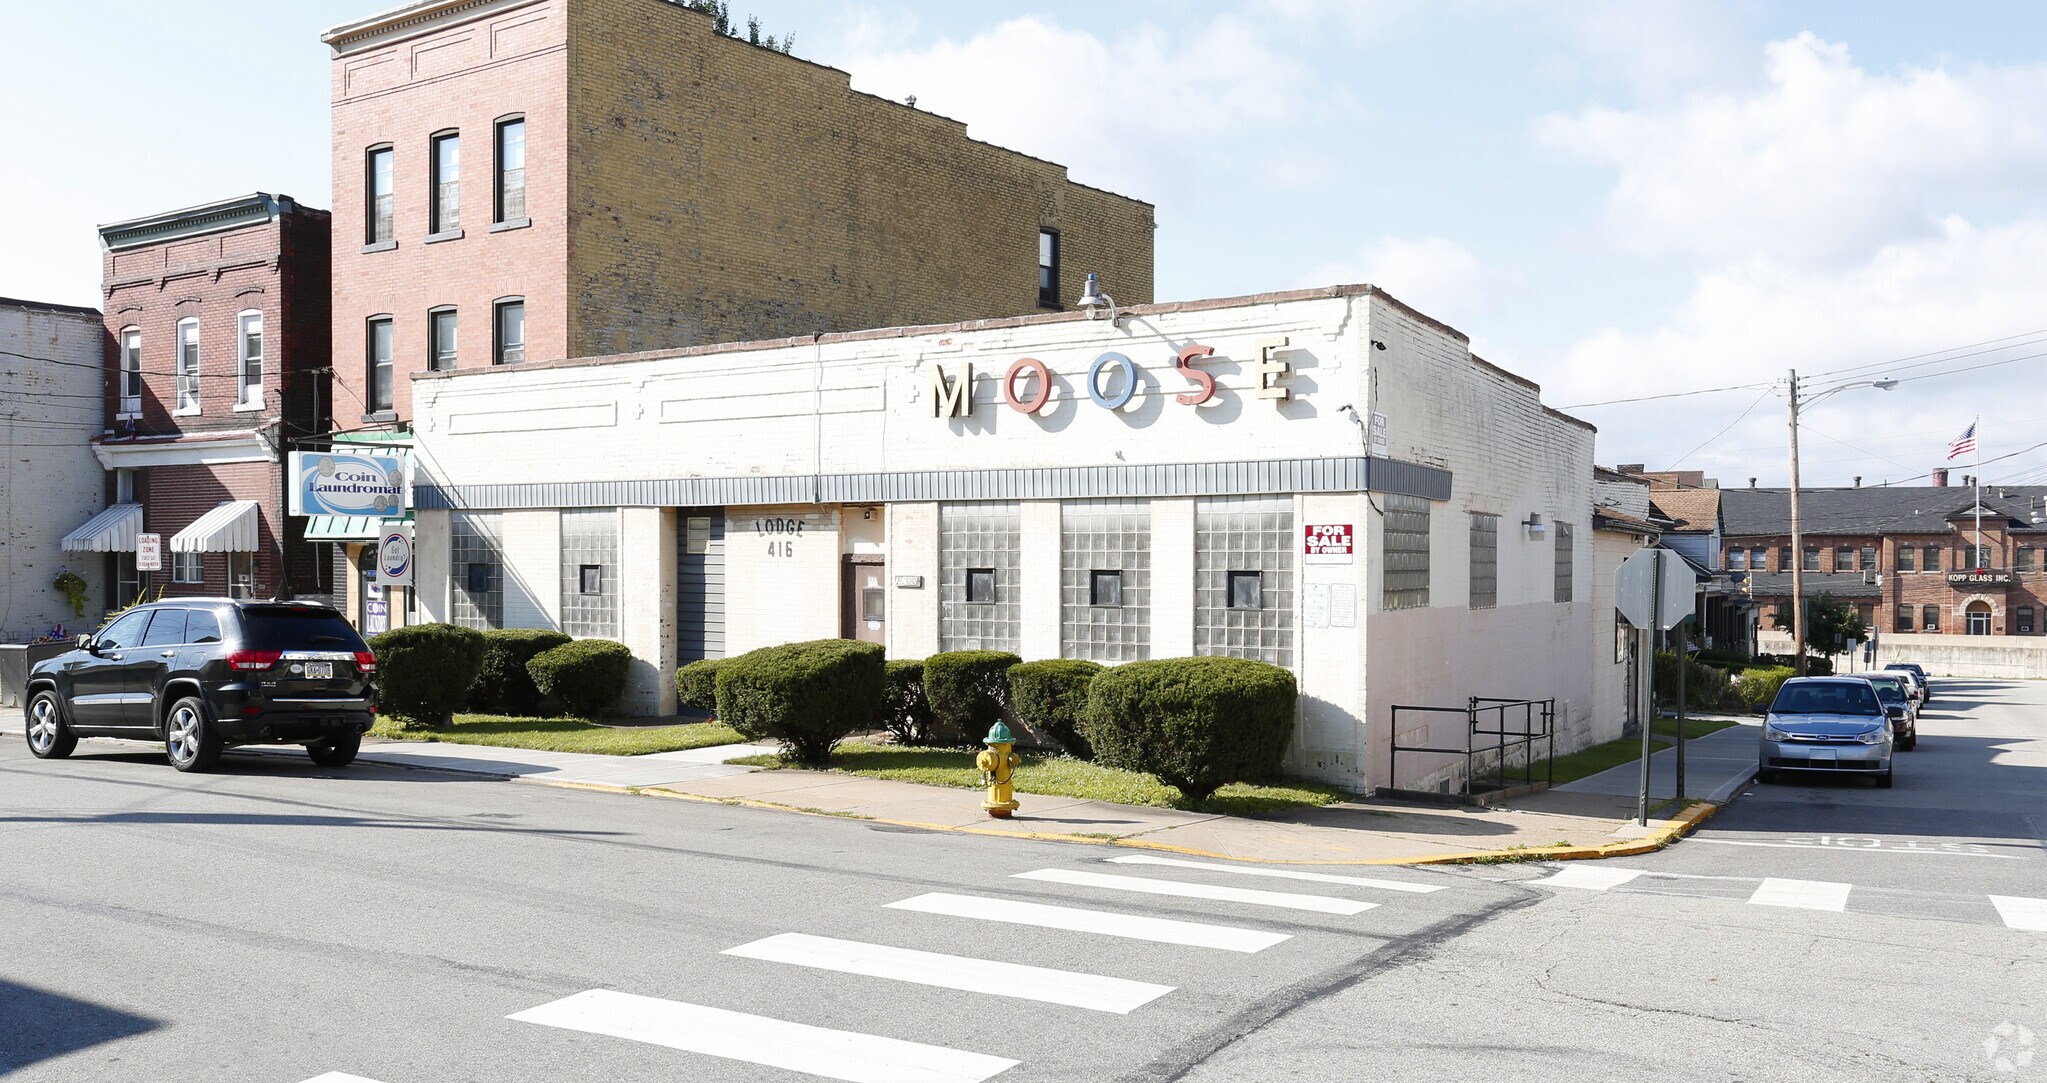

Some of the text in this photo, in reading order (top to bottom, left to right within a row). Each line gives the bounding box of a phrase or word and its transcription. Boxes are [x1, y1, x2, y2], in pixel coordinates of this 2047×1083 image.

[929, 336, 1290, 419] MOOSE
[1374, 415, 1385, 427] FOR
[1373, 424, 1386, 438] SALE
[334, 472, 377, 483] Coin
[309, 482, 401, 494] Laundromat
[756, 517, 805, 538] LODGE
[1312, 525, 1345, 536] FOR
[1306, 535, 1352, 547] SALE
[391, 545, 400, 554] Got
[767, 541, 792, 557] 416
[1310, 546, 1348, 554] BY OWNER
[1948, 574, 2011, 582] KOPP GLASS INC.
[367, 602, 387, 614] COIN
